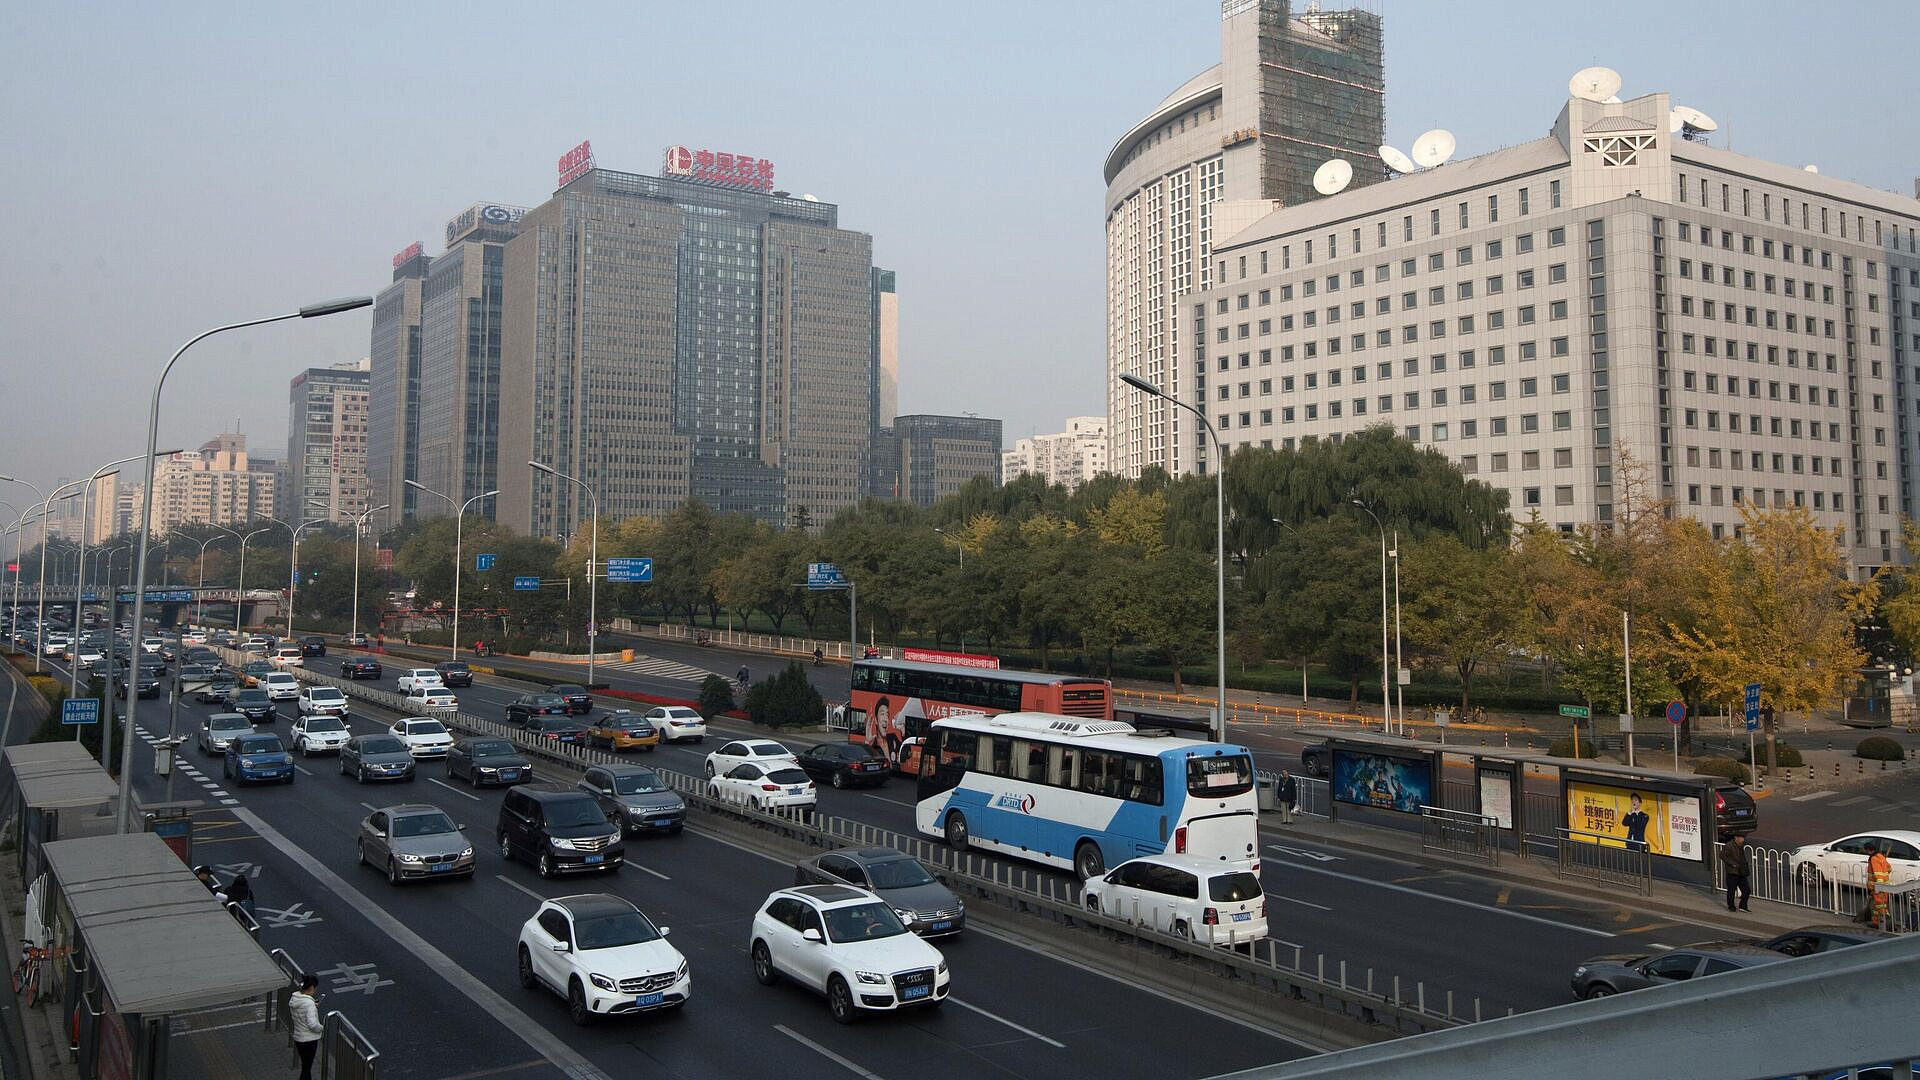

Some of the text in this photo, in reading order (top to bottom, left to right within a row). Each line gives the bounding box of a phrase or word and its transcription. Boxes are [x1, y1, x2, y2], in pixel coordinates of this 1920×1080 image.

[696, 149, 775, 179] 中国石化
[66, 702, 96, 711] 为了您的安全
[929, 705, 948, 718] 人人车
[1584, 796, 1604, 805] 双十一
[1584, 805, 1615, 821] 挑新的
[1584, 817, 1615, 832] 上苏宁
